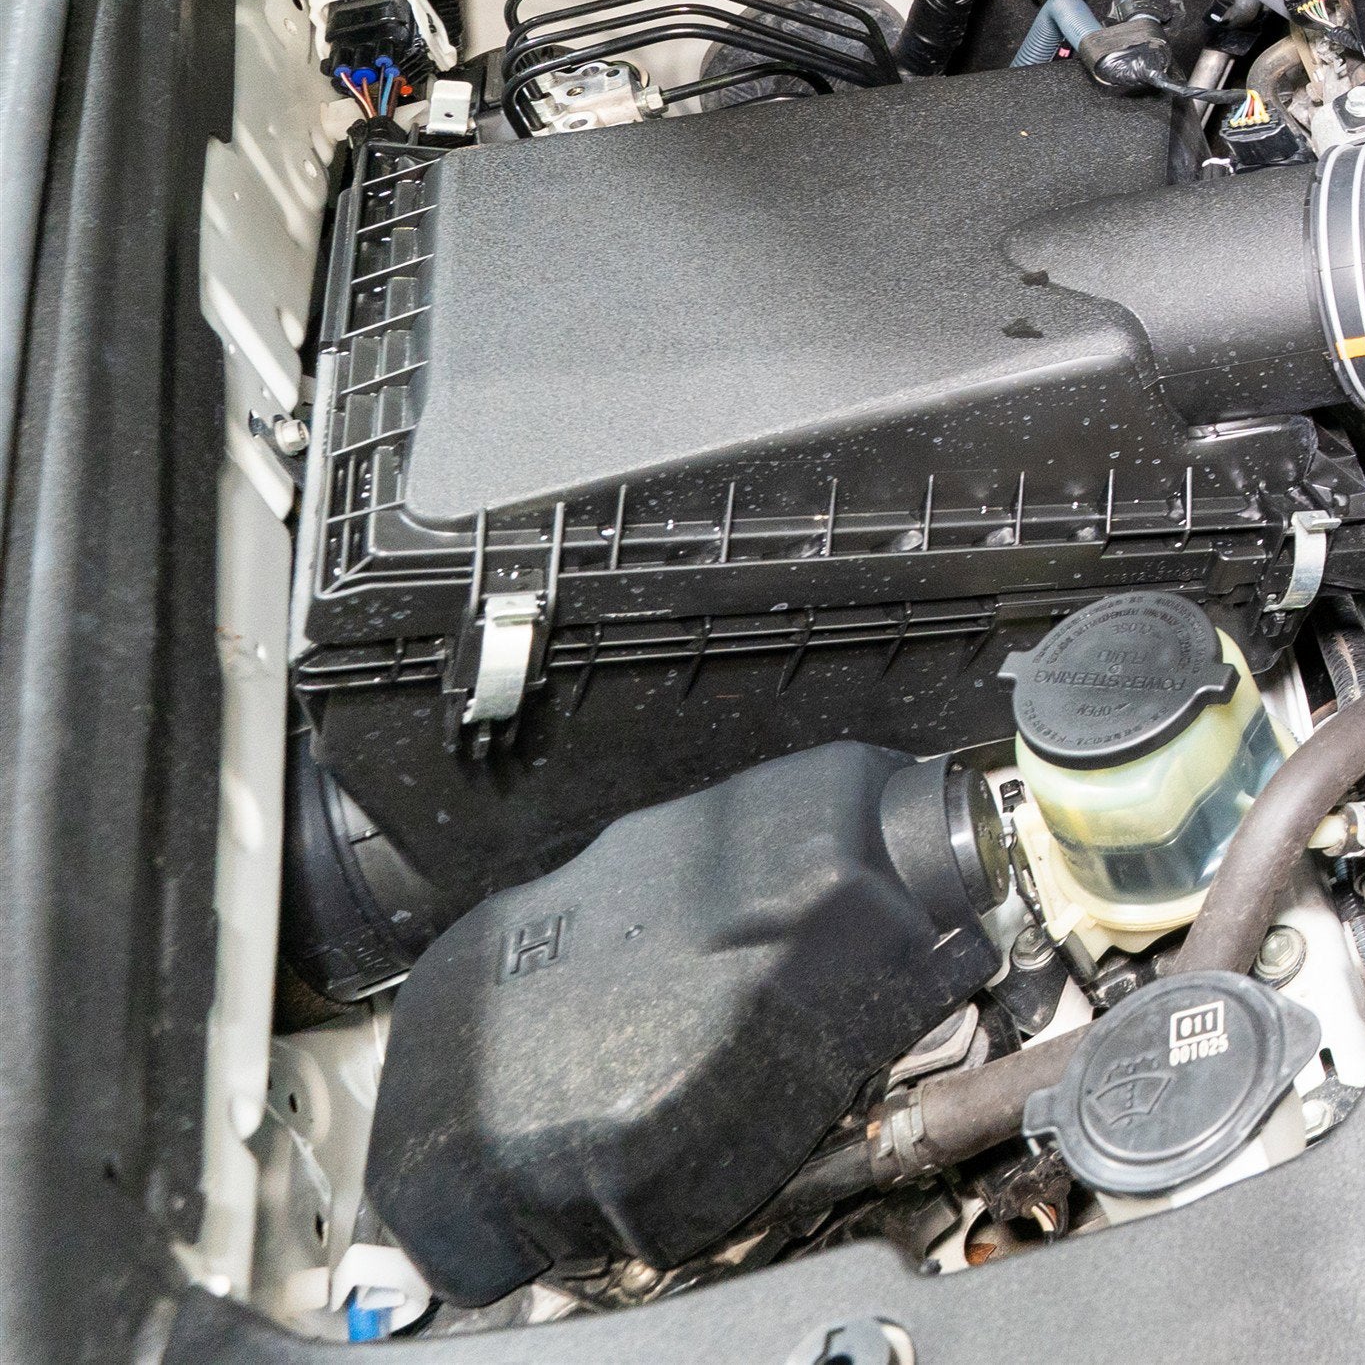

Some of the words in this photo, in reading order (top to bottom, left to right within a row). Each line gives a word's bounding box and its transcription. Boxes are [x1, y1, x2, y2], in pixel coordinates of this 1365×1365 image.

[1097, 650, 1149, 665] FLUID
[1032, 669, 1122, 689] STEERING
[1124, 675, 1187, 692] POWER
[1076, 704, 1112, 717] OPEN
